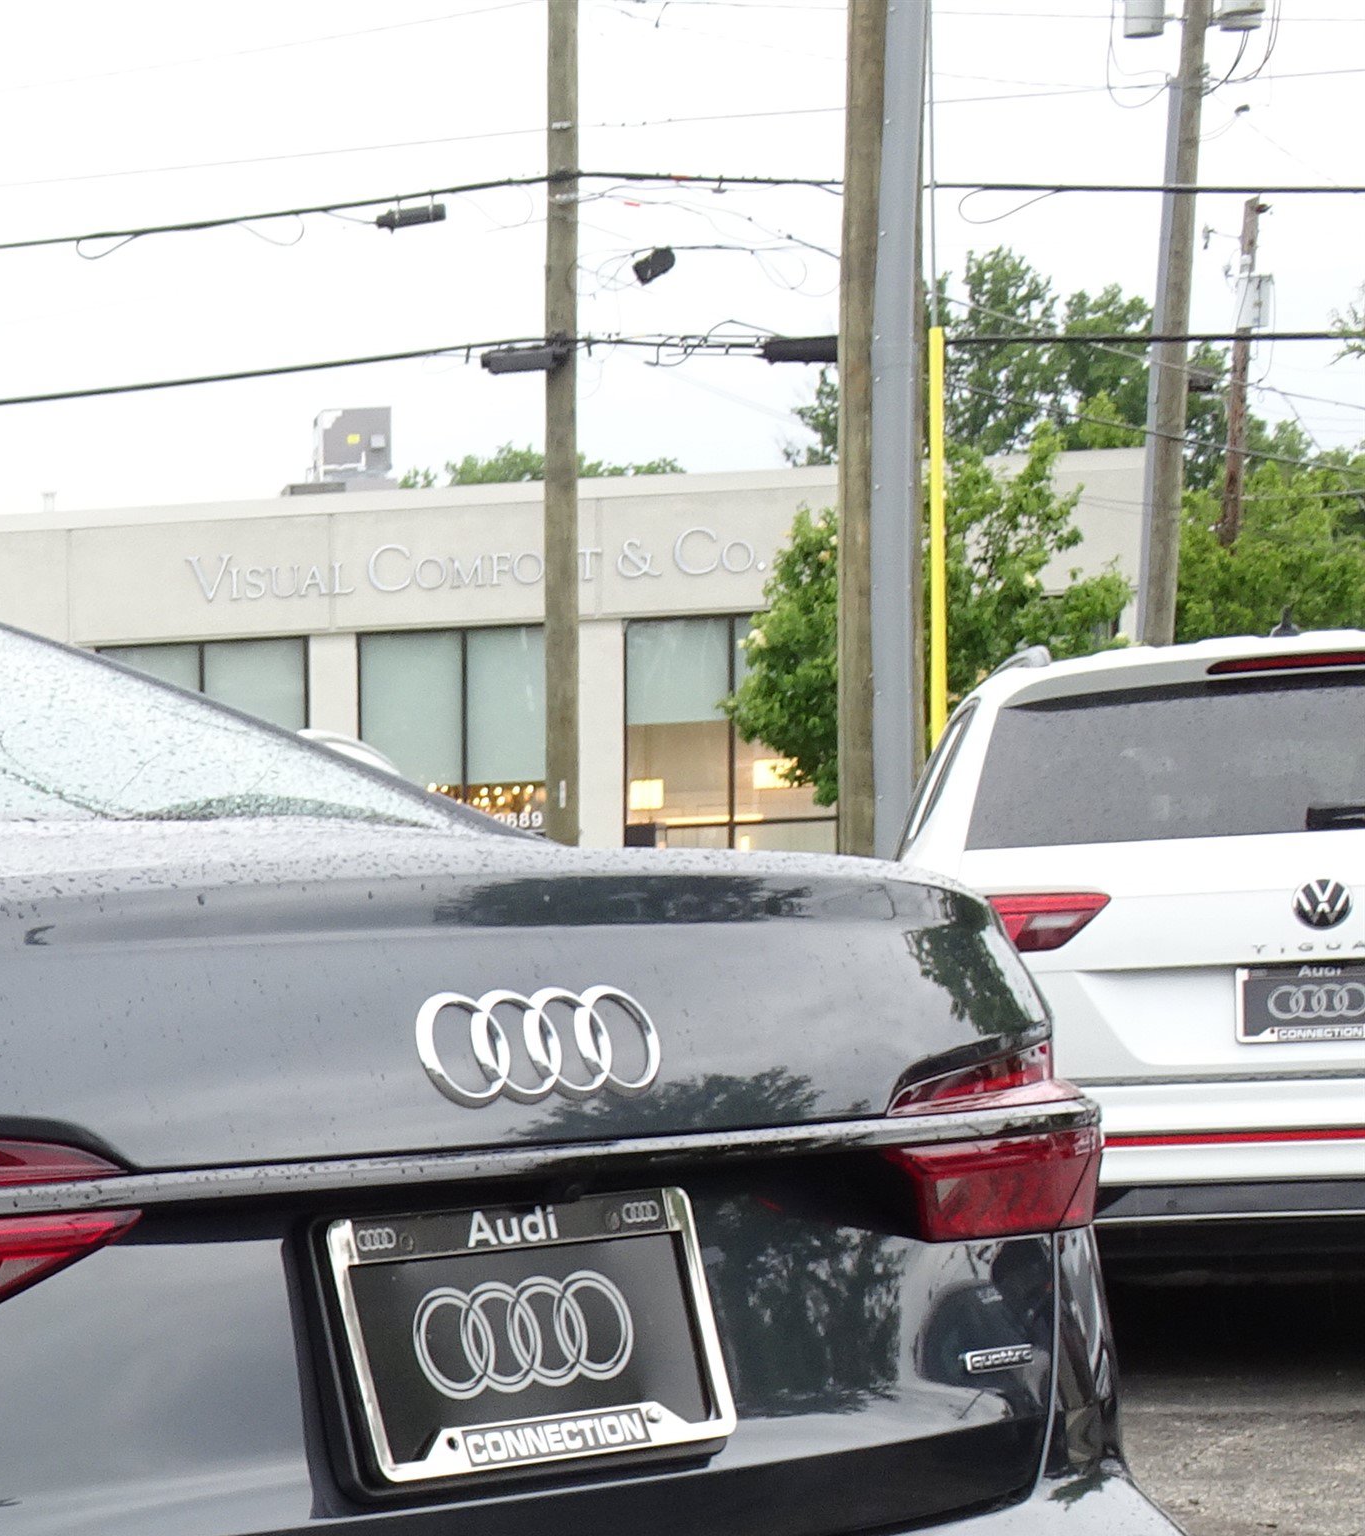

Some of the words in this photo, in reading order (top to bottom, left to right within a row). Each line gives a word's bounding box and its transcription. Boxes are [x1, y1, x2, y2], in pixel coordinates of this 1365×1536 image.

[367, 543, 603, 592] COMFOT
[617, 537, 663, 579] &
[1298, 965, 1342, 978] Audi
[1278, 1026, 1363, 1040] CONNECTION
[467, 1204, 559, 1248] Audi
[971, 1349, 1034, 1369] quattro
[465, 1412, 647, 1464] CONNECTION
